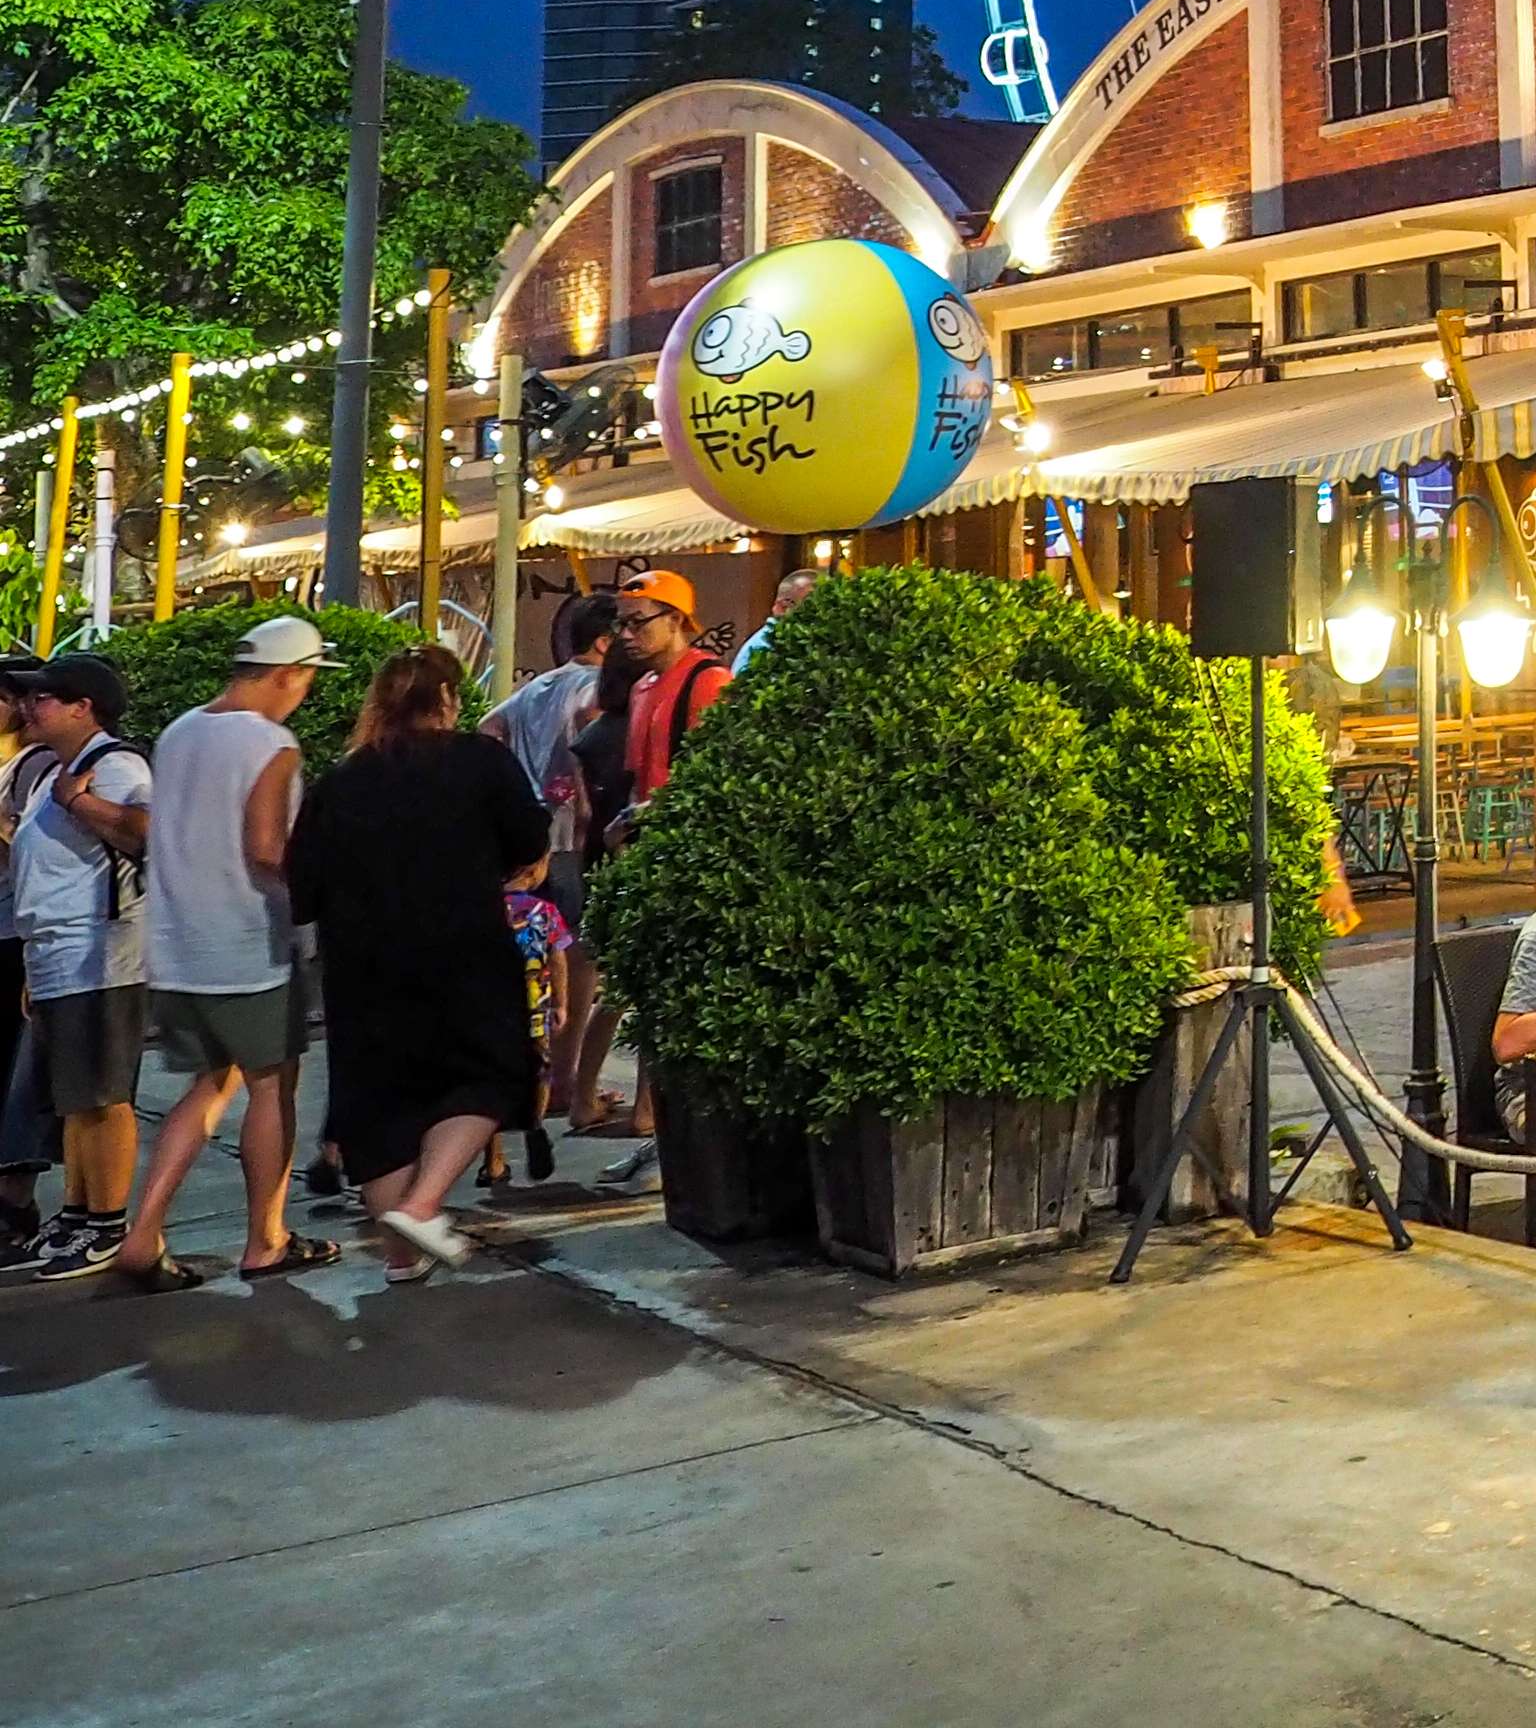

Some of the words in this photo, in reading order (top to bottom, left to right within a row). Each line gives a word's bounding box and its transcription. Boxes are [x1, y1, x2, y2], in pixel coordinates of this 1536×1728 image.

[1095, 38, 1152, 112] THE
[688, 388, 816, 430] Happy
[694, 424, 817, 475] Fish
